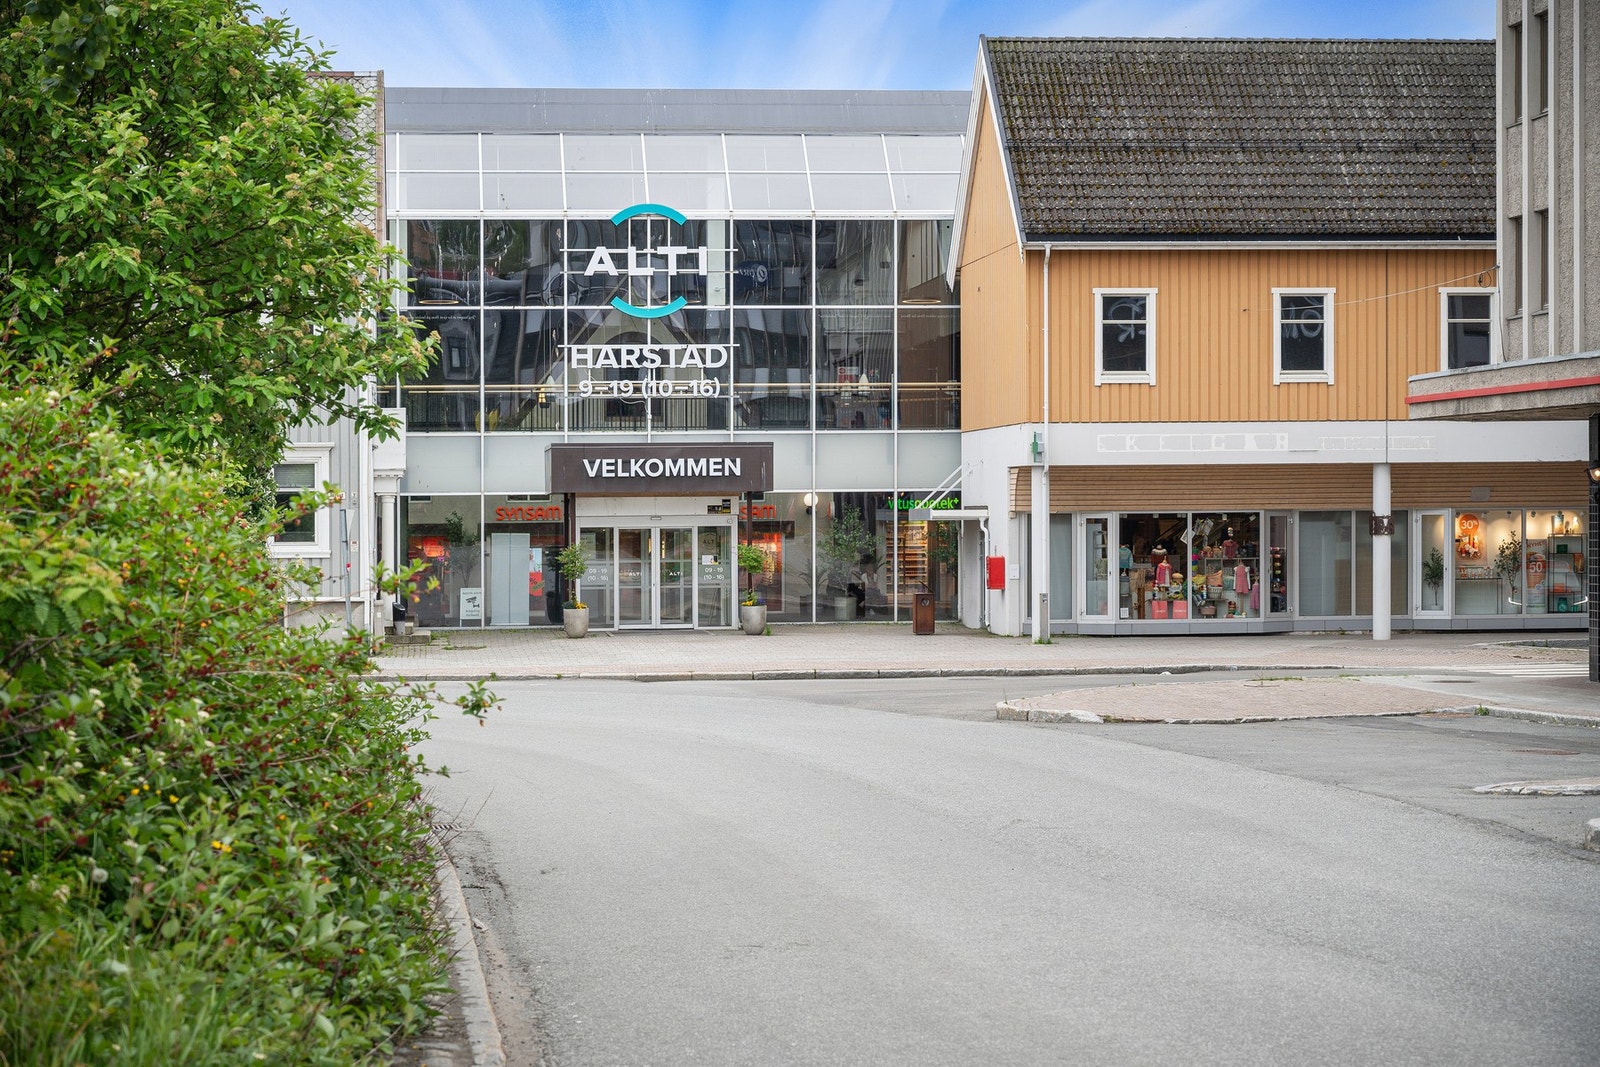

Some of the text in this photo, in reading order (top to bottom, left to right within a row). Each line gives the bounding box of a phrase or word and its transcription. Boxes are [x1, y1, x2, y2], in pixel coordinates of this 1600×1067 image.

[584, 246, 708, 276] ALTI
[571, 345, 728, 369] HARSTAD
[582, 457, 741, 478] VELKOMMEN
